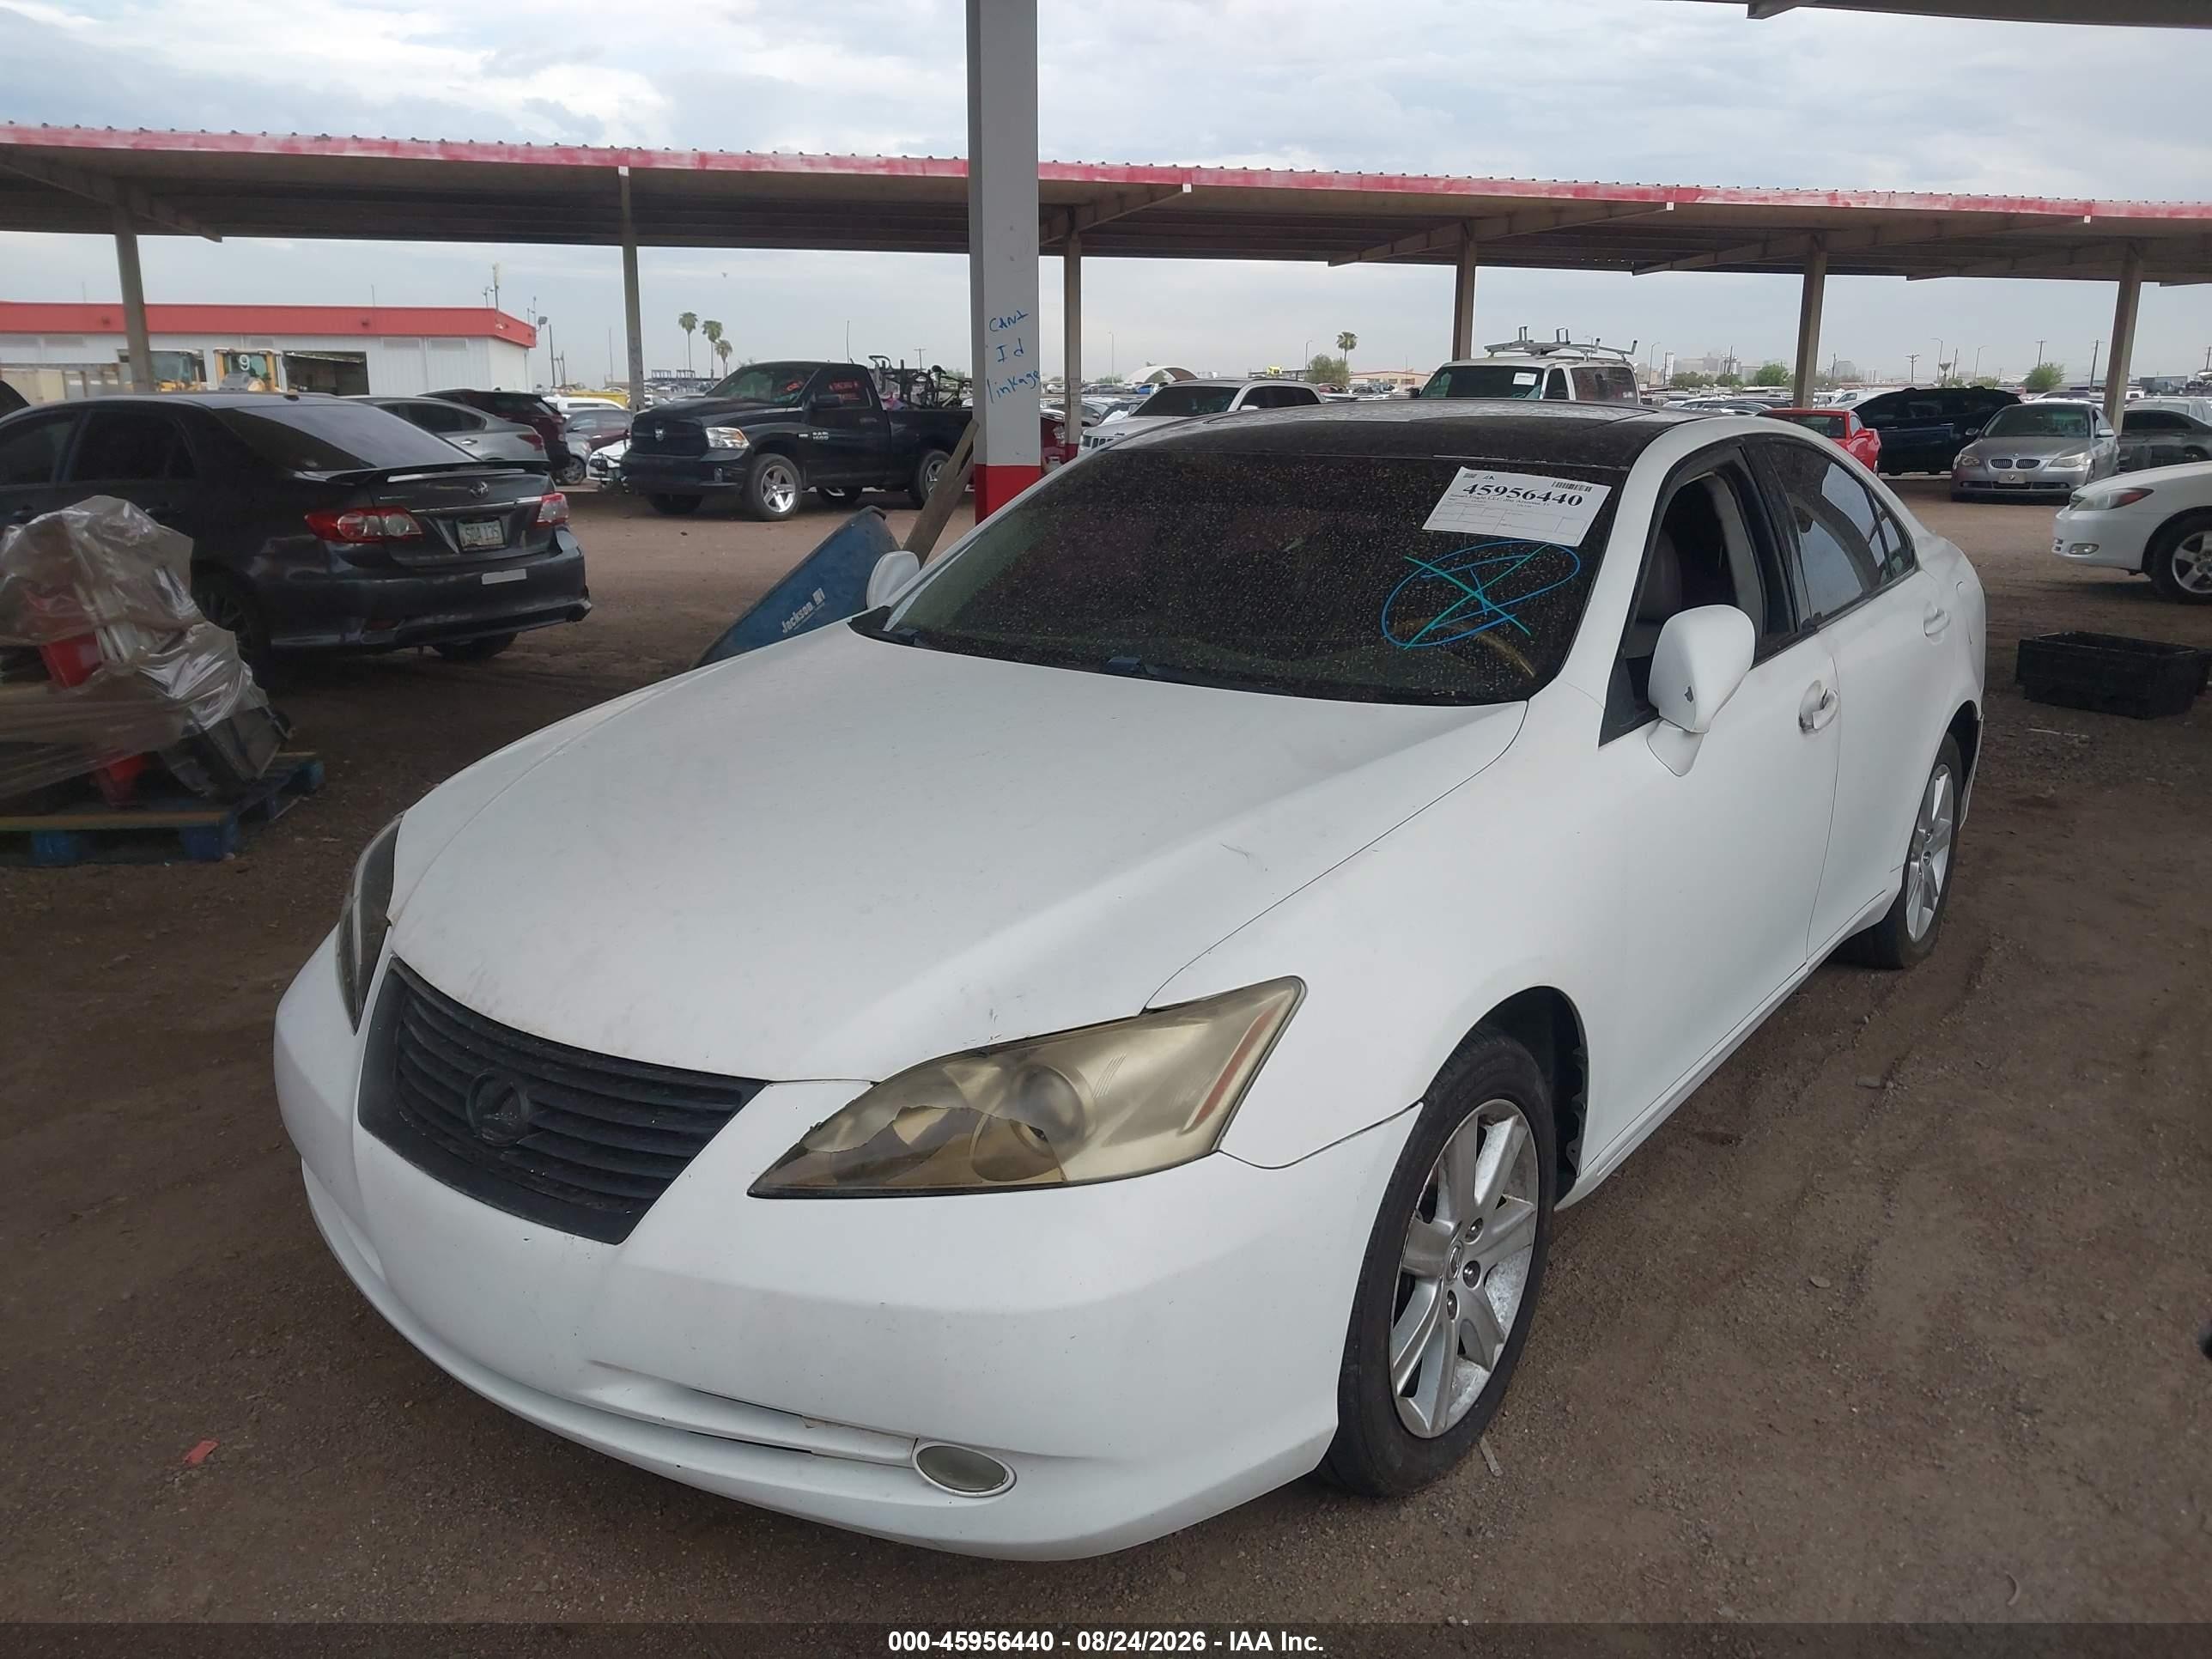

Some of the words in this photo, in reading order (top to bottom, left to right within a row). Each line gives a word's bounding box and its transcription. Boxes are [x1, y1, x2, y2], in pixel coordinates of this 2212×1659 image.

[239, 354, 251, 371] 9
[1462, 483, 1583, 506] 45956440
[782, 601, 814, 634] Jackson
